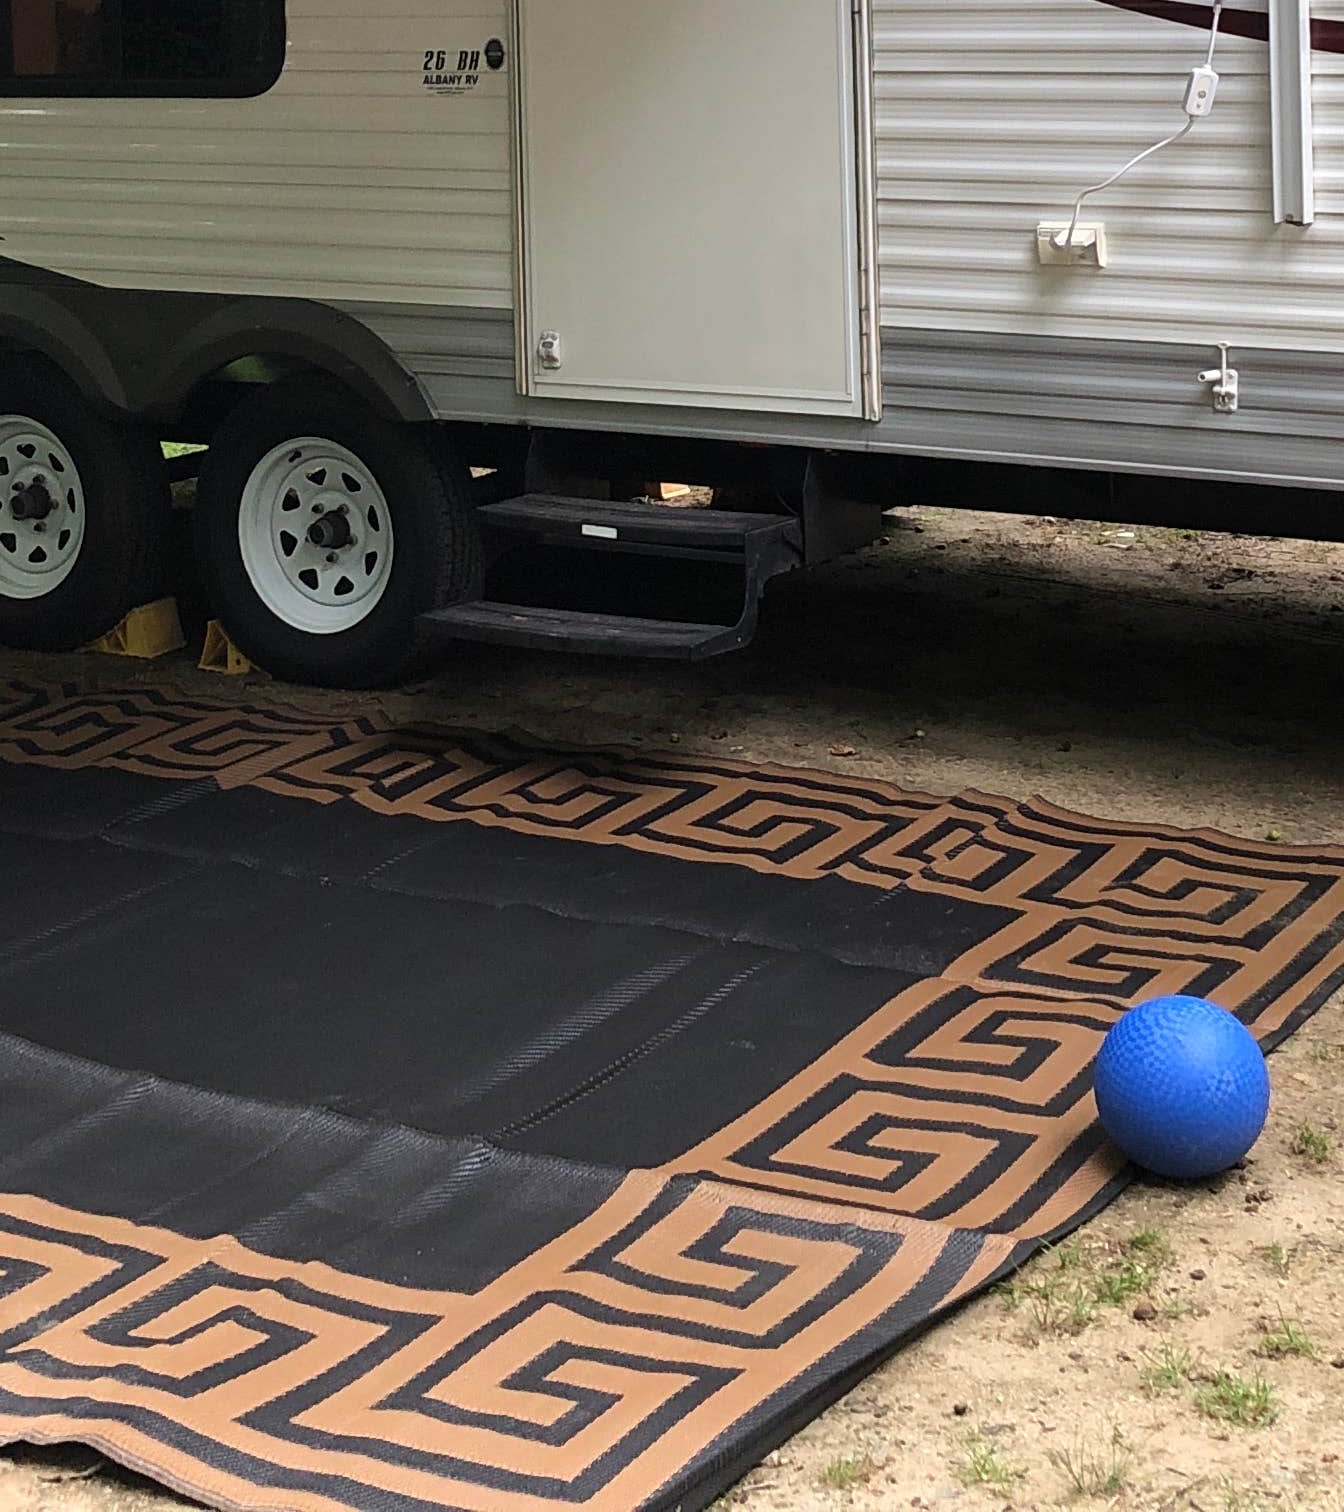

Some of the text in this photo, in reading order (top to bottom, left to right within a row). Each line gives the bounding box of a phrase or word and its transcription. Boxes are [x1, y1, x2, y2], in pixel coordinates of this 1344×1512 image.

[422, 49, 481, 71] 26 BH
[422, 74, 479, 85] ALBANY RV
